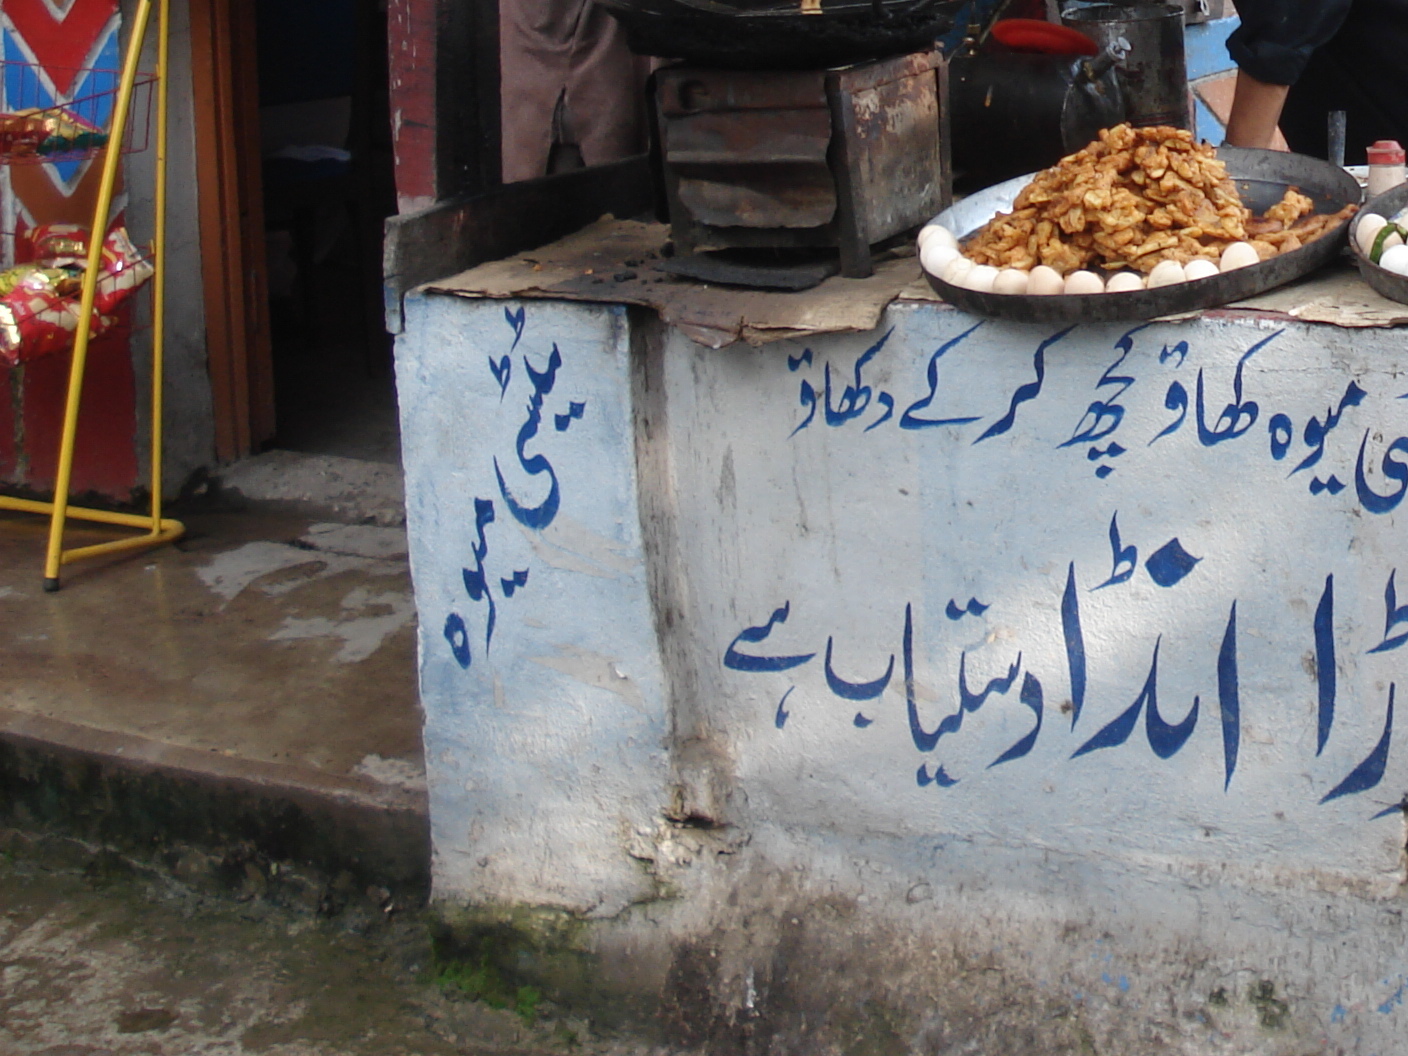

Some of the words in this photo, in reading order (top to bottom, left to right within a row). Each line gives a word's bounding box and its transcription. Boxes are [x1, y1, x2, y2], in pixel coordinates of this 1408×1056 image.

[899, 319, 987, 430] کے
[971, 323, 1080, 445] کر
[1269, 379, 1368, 496] میوہ
[722, 599, 816, 730] ہے
[824, 597, 1045, 788] دستیاب
